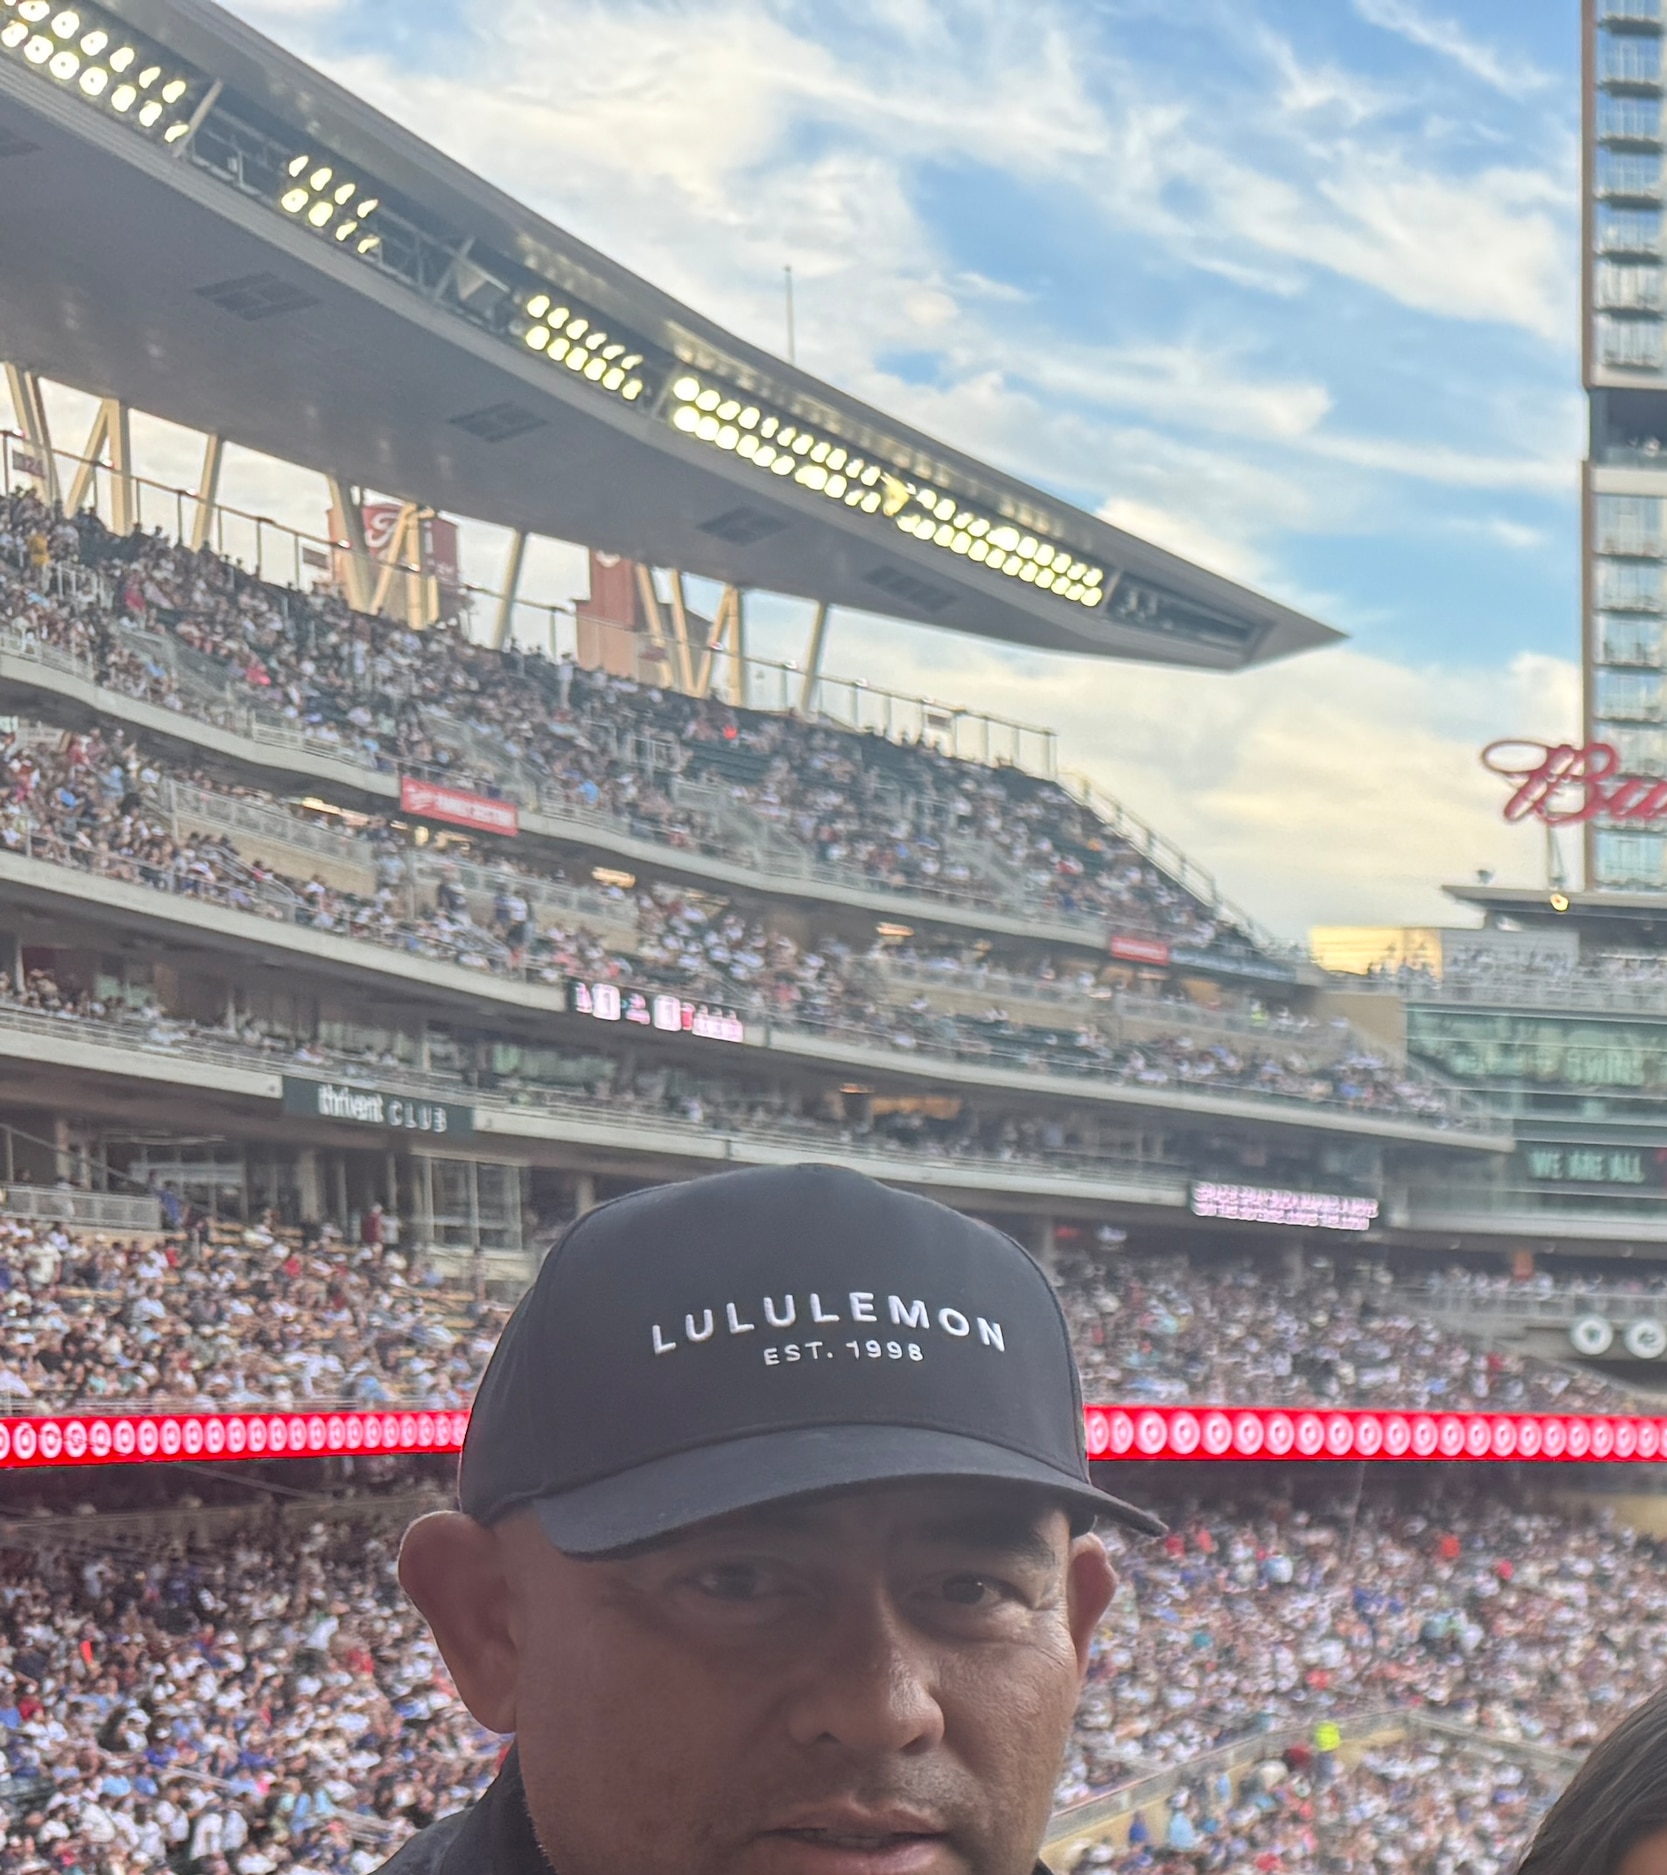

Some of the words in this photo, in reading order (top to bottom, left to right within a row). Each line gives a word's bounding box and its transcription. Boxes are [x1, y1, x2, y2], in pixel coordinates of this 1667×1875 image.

[388, 1100, 447, 1133] CLUB
[651, 1292, 1006, 1354] LULULEMON
[763, 1341, 834, 1366] EST.
[845, 1340, 924, 1363] 1998
